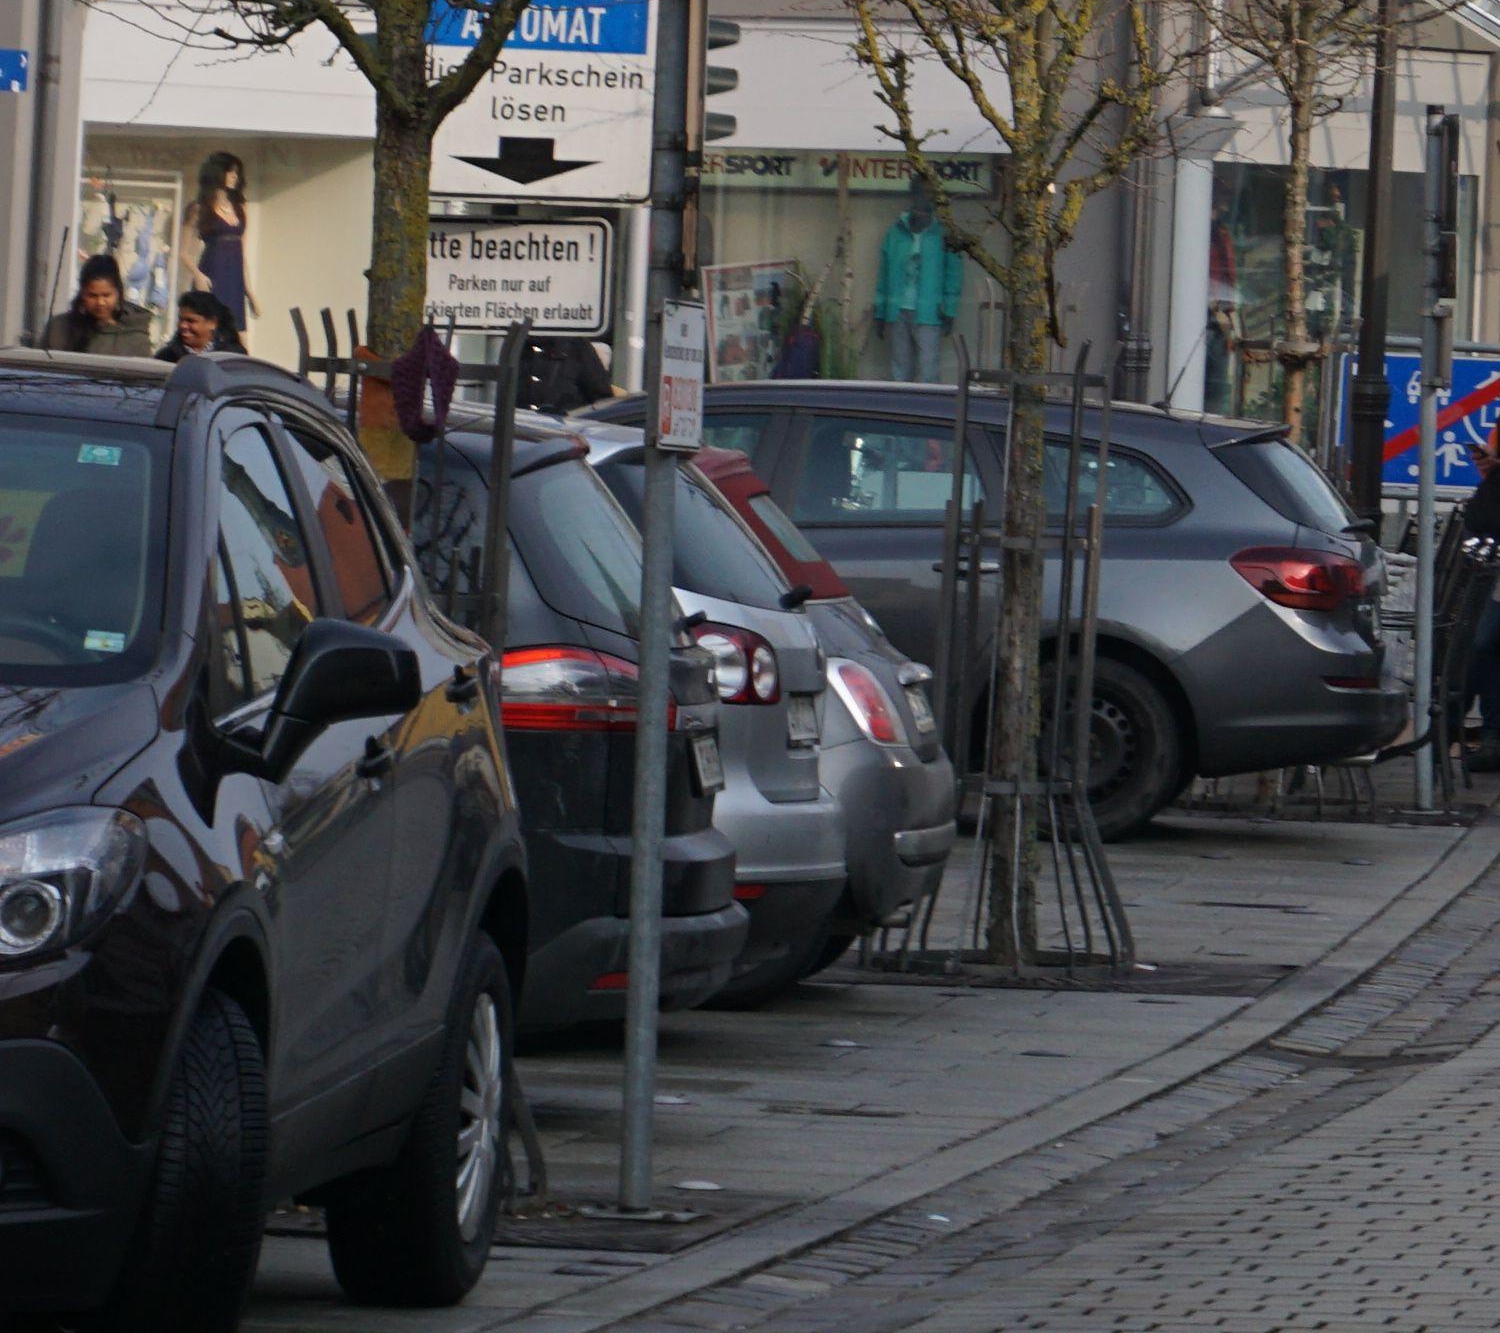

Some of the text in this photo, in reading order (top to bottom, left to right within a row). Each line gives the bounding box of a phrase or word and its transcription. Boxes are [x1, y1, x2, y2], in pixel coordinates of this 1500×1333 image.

[461, 6, 607, 46] AOMAT
[490, 60, 644, 90] Parkschein
[492, 96, 566, 122] lösen
[429, 232, 462, 259] tte
[470, 231, 579, 262] beachten
[448, 273, 552, 293] Parken nur auf
[485, 300, 539, 320] Flächen
[543, 302, 593, 321] erlaubt
